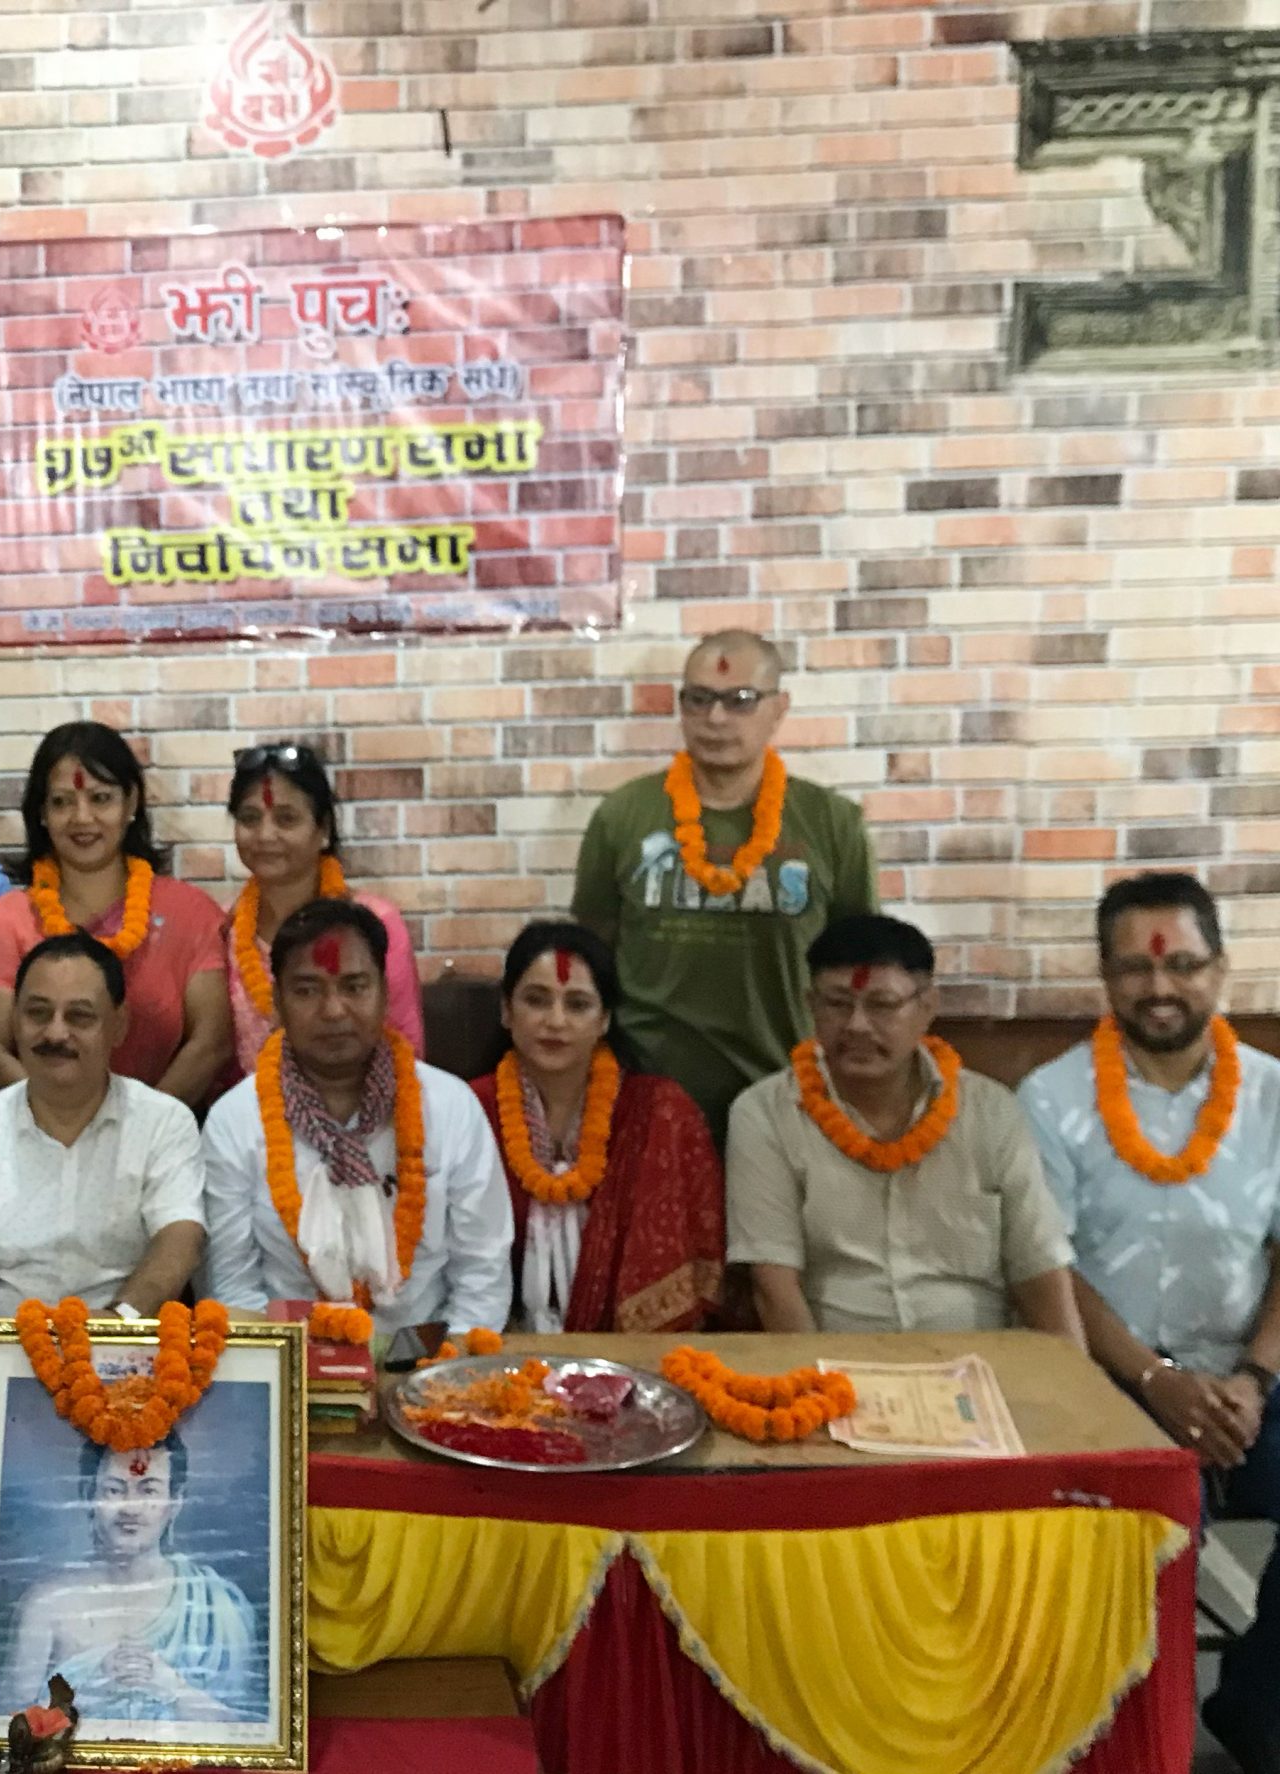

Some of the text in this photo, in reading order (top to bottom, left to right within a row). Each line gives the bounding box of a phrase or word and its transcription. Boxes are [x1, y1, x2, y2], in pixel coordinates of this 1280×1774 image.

[165, 265, 261, 339] झी
[406, 429, 535, 468] सभा
[237, 484, 346, 525] तथा
[338, 529, 470, 572] सभा
